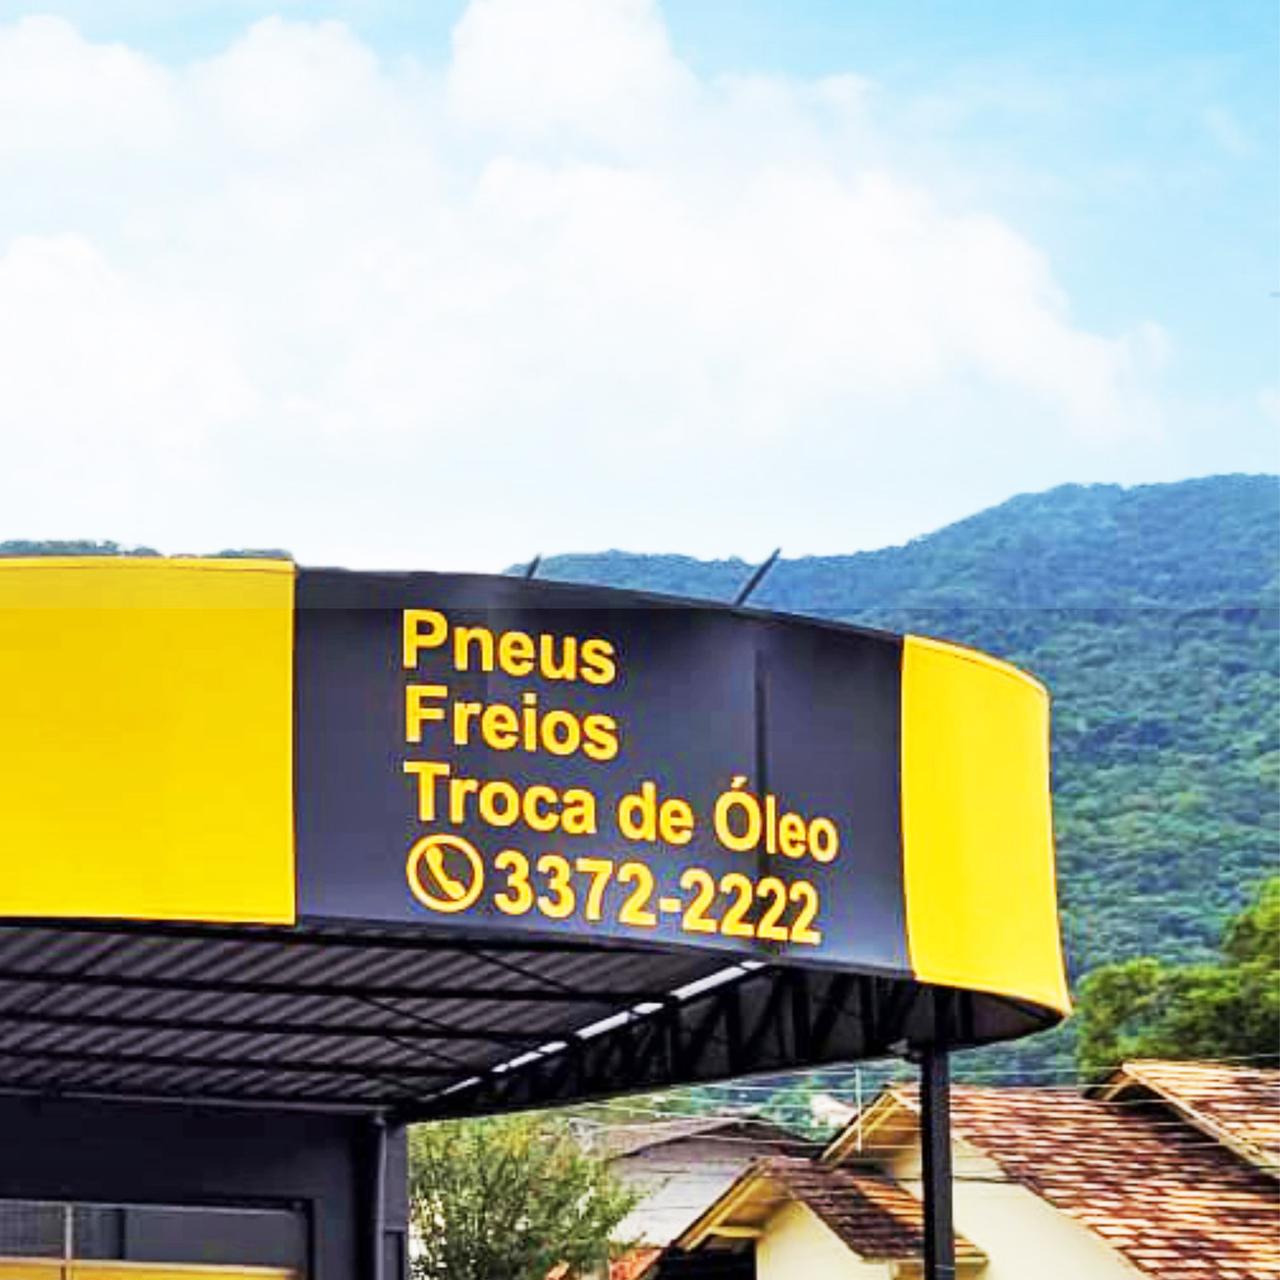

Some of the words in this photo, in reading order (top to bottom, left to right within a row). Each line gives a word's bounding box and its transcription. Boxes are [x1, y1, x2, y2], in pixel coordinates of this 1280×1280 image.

[401, 608, 617, 686] Pneus
[404, 685, 620, 762] Freios
[404, 761, 597, 835] Troca
[618, 781, 695, 846] de
[713, 776, 839, 863] Óleo
[493, 850, 823, 945] 3372-2222
